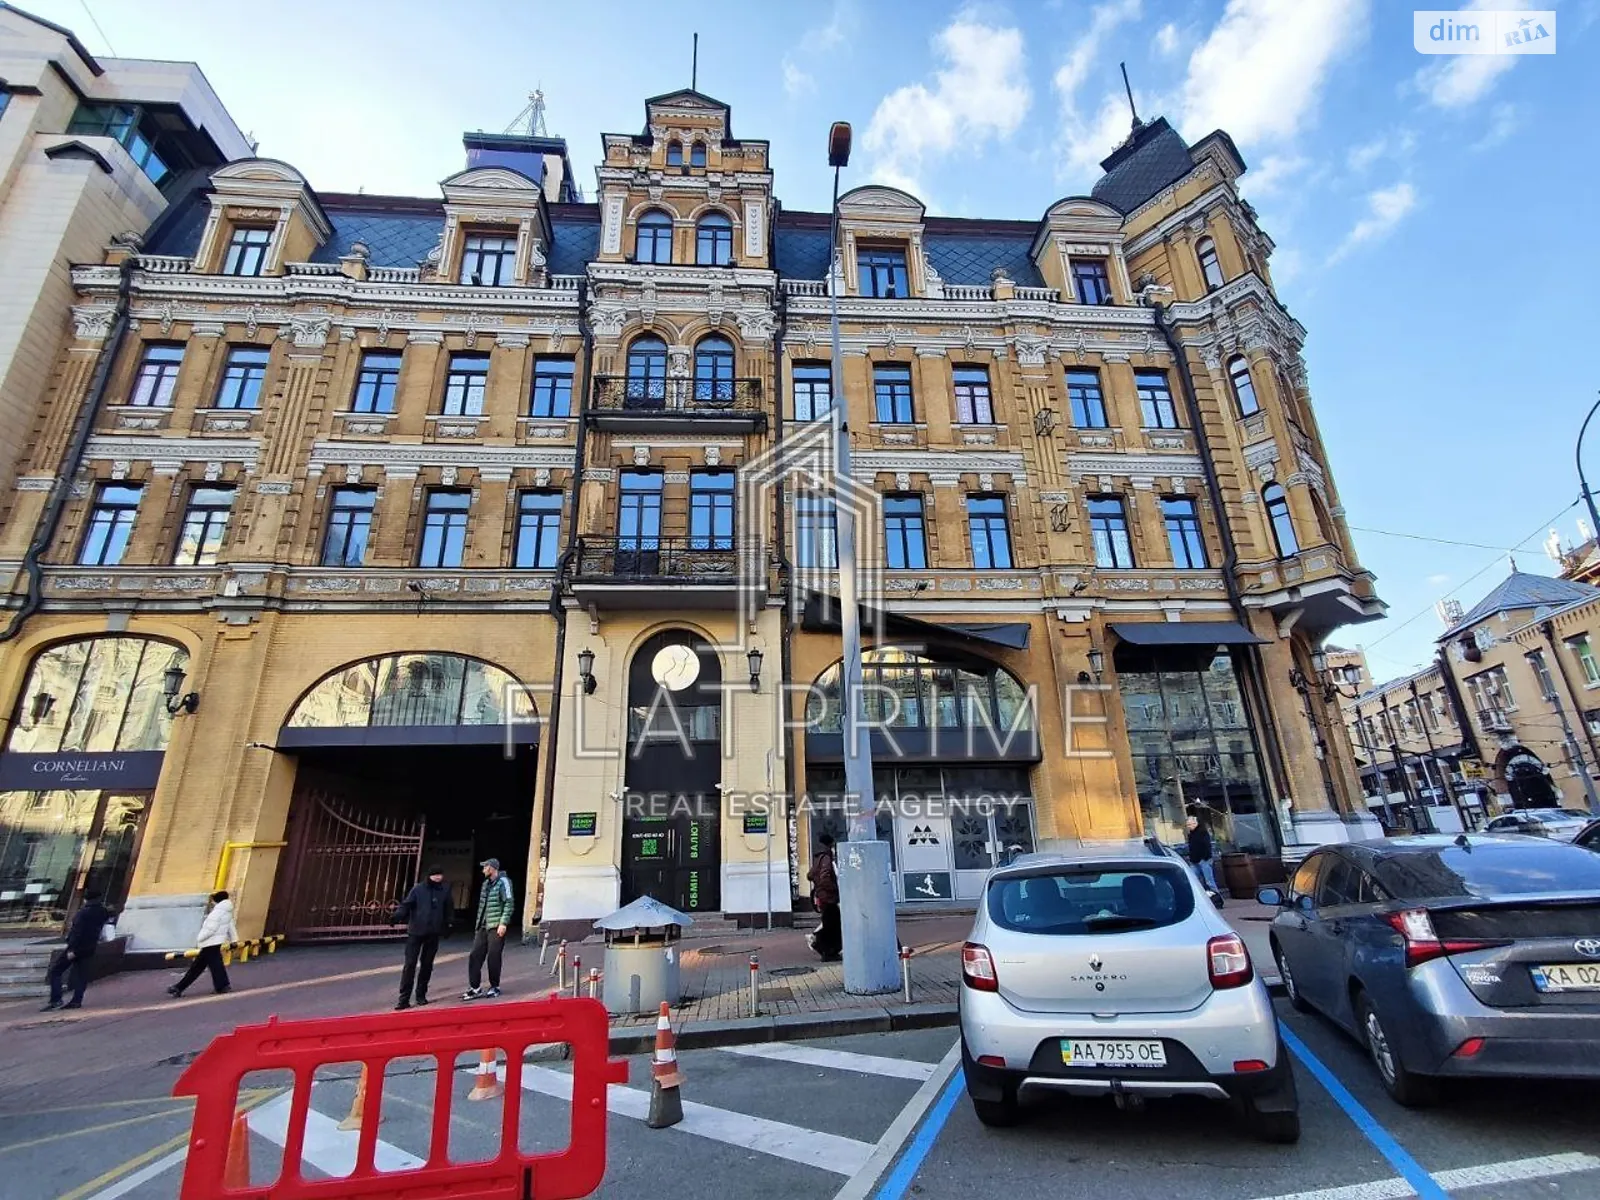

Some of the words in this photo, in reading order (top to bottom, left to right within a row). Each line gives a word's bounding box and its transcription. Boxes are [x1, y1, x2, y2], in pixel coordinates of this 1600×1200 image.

[33, 760, 126, 773] CORNELIANI
[690, 820, 699, 858] ВАЛЮТ
[690, 871, 698, 908] ОБМІН
[1070, 974, 1127, 982] SANDERO
[1542, 967, 1574, 986] KA
[1097, 1043, 1135, 1061] 7955
